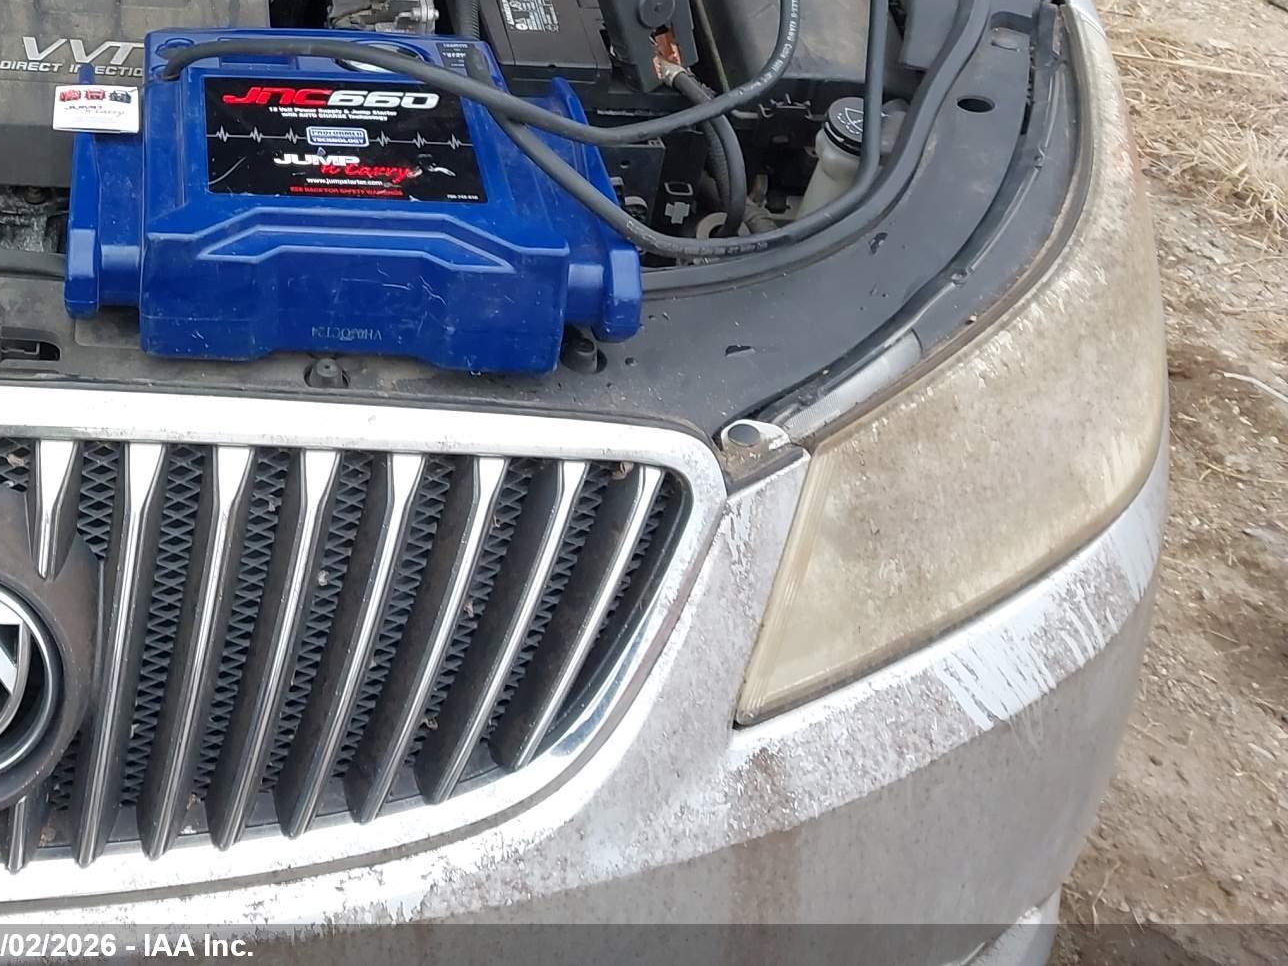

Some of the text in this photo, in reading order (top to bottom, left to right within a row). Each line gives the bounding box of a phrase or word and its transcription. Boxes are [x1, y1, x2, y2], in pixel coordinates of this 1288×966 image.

[22, 35, 145, 65] VVT
[0, 60, 62, 73] DIRECT
[222, 87, 440, 109] JNC660
[312, 136, 364, 144] TECHNOLOGY
[274, 153, 360, 166] JUMP
[306, 178, 383, 186] www.jumpstarter.com
